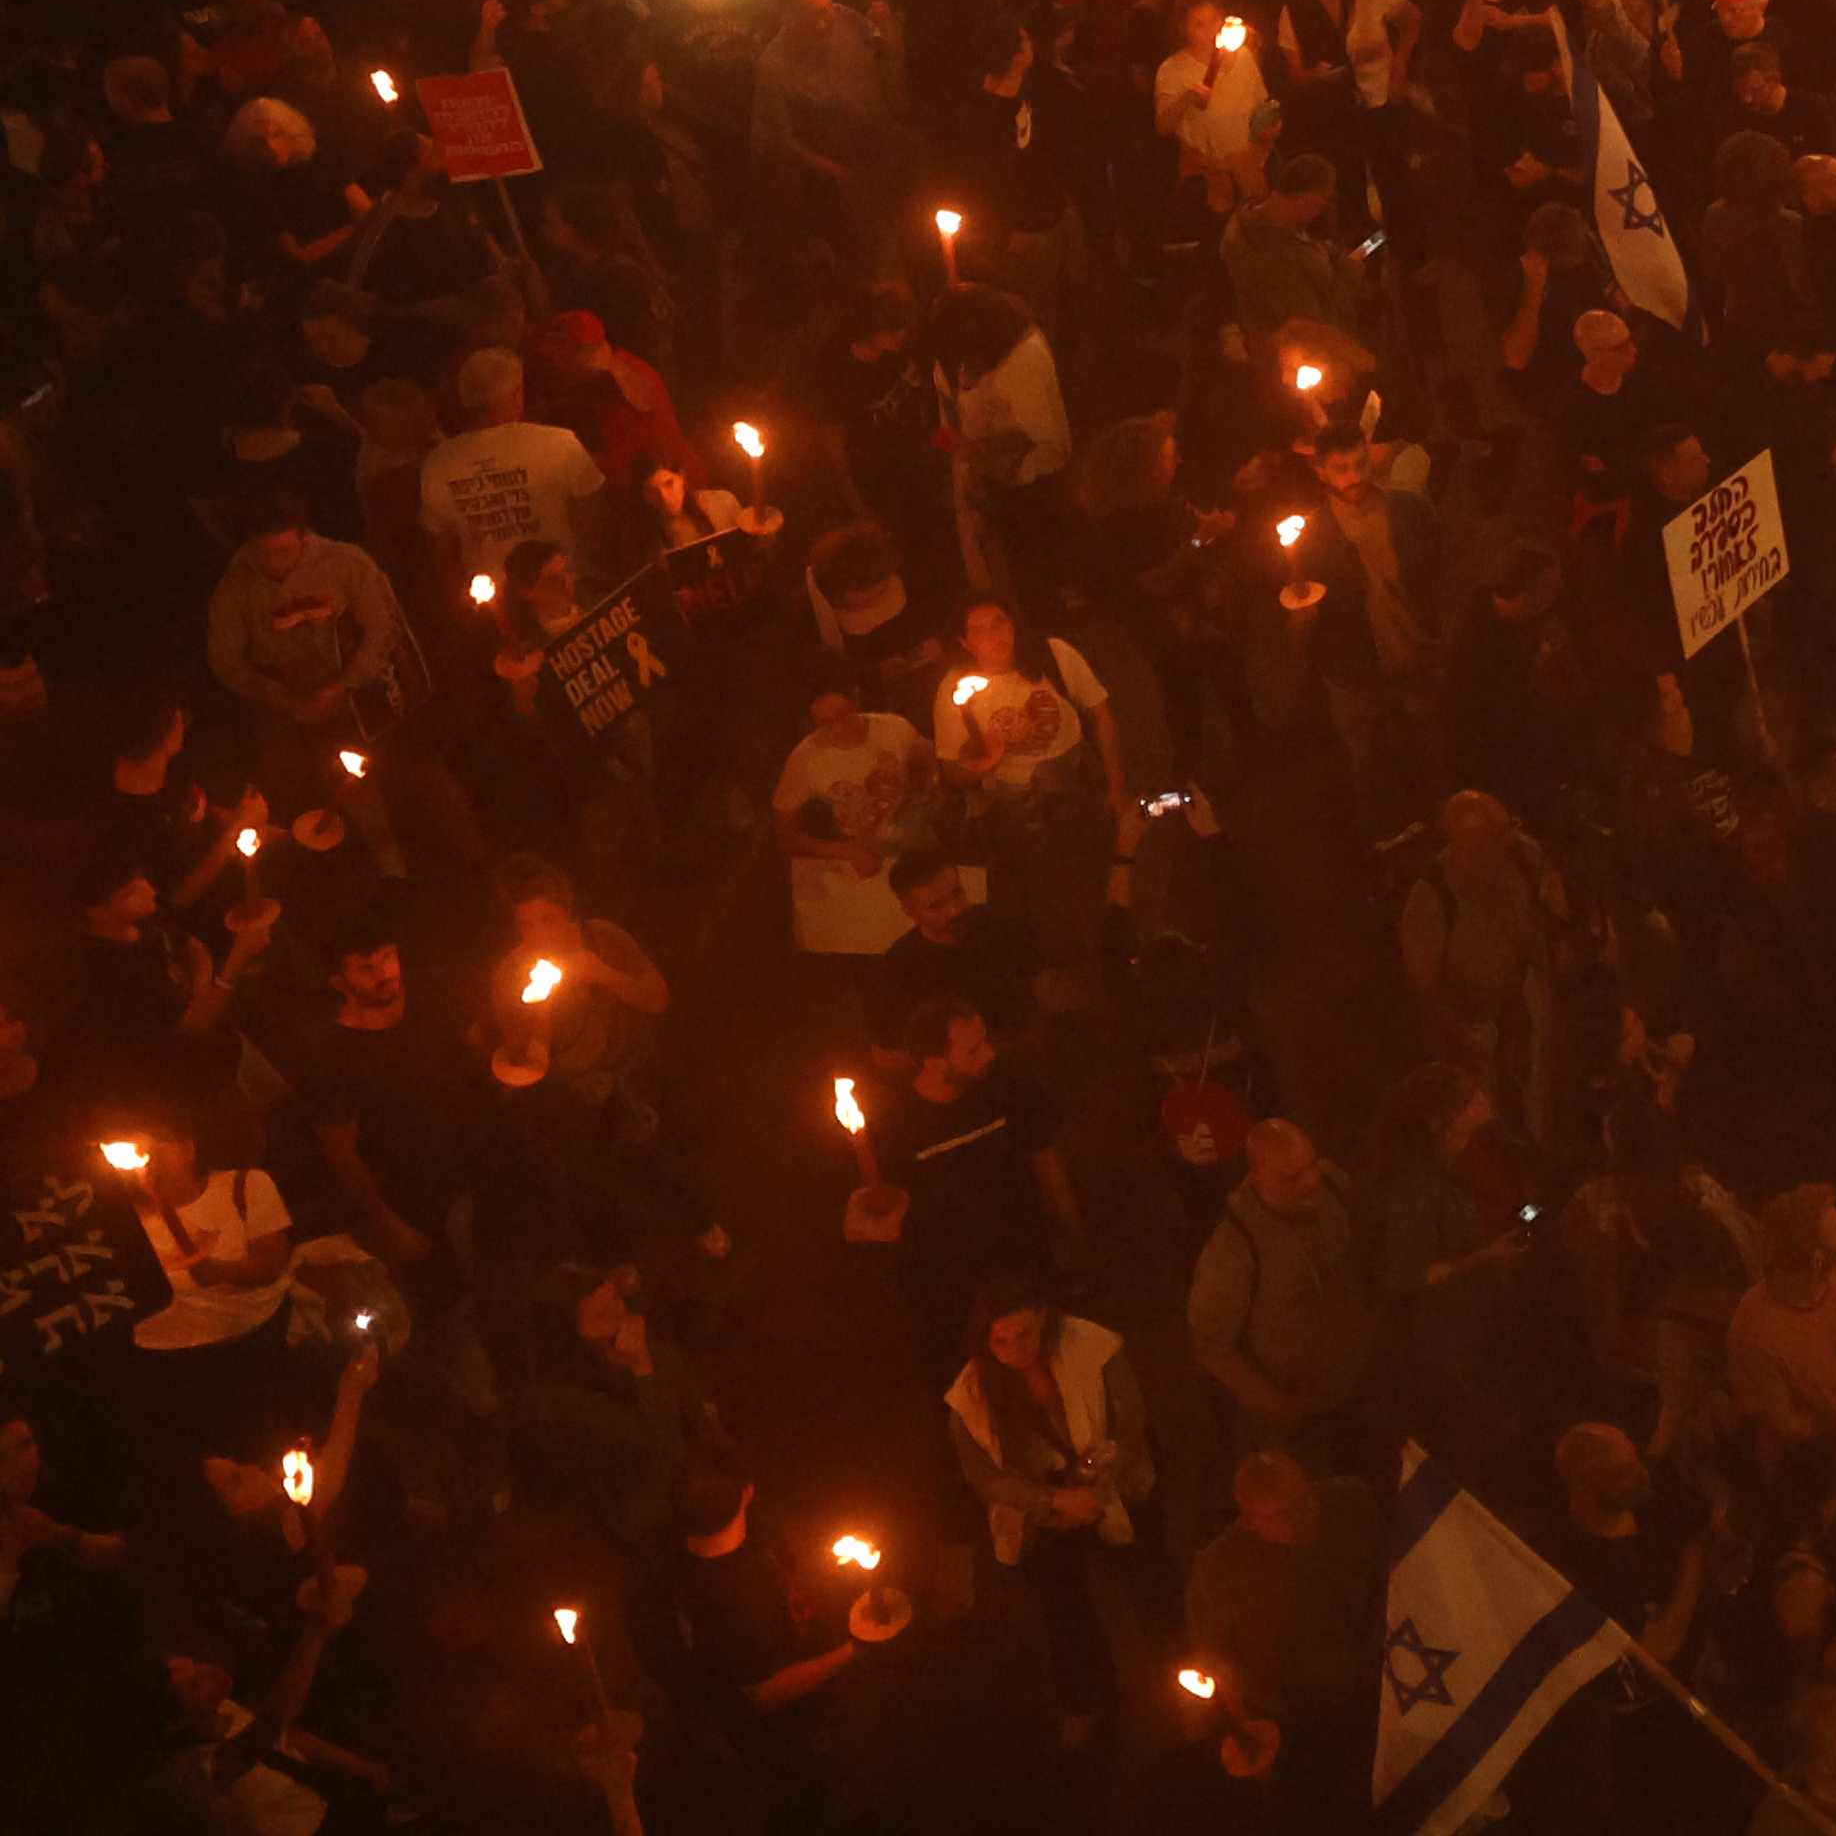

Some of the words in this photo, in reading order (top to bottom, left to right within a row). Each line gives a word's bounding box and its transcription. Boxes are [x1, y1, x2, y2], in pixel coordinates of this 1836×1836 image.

[550, 594, 645, 684] HOSTAGE
[562, 658, 625, 710] DEAL
[576, 684, 636, 739] NOW
